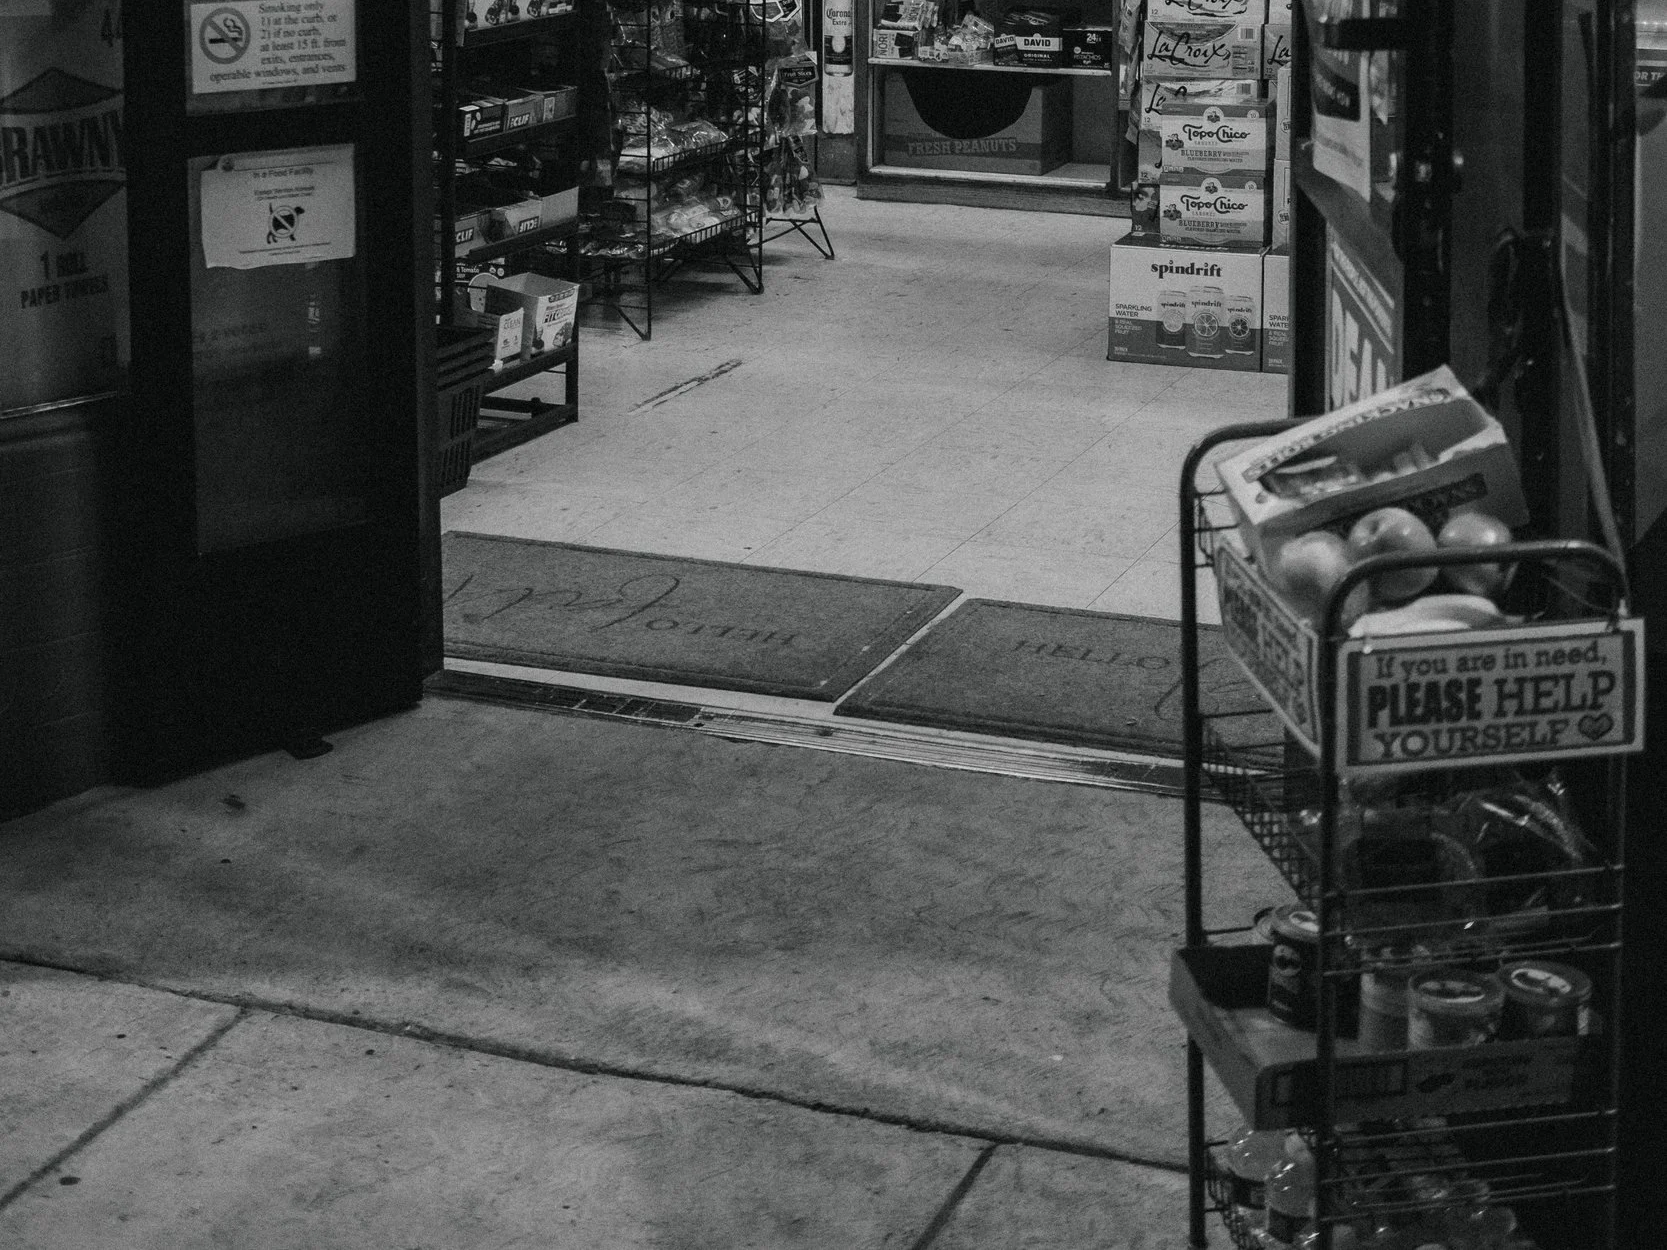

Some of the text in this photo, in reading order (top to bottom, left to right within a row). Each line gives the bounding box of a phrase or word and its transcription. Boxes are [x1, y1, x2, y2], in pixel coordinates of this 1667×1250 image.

[826, 8, 851, 19] Corona
[878, 33, 888, 56] NORI
[1023, 38, 1051, 47] DAVID
[512, 113, 530, 128] CLIF
[1182, 123, 1250, 143] Topo Chico
[908, 138, 1017, 155] FRESH PEANUTS
[1180, 194, 1248, 214] Topo Chico
[1178, 219, 1219, 227] BLUEBERRY
[455, 228, 474, 242] CLIF
[460, 266, 480, 274] Tomato
[1151, 259, 1222, 279] spindrift
[21, 284, 61, 309] PAPER
[1191, 299, 1222, 308] spindrift
[1115, 303, 1152, 312] SPARKLING
[1160, 301, 1186, 309] spindrift
[1115, 310, 1139, 318] WATER
[1376, 640, 1607, 682] If you are in need,
[1367, 670, 1616, 729] PLEASE HELP
[1374, 718, 1570, 759] YOURSELF
